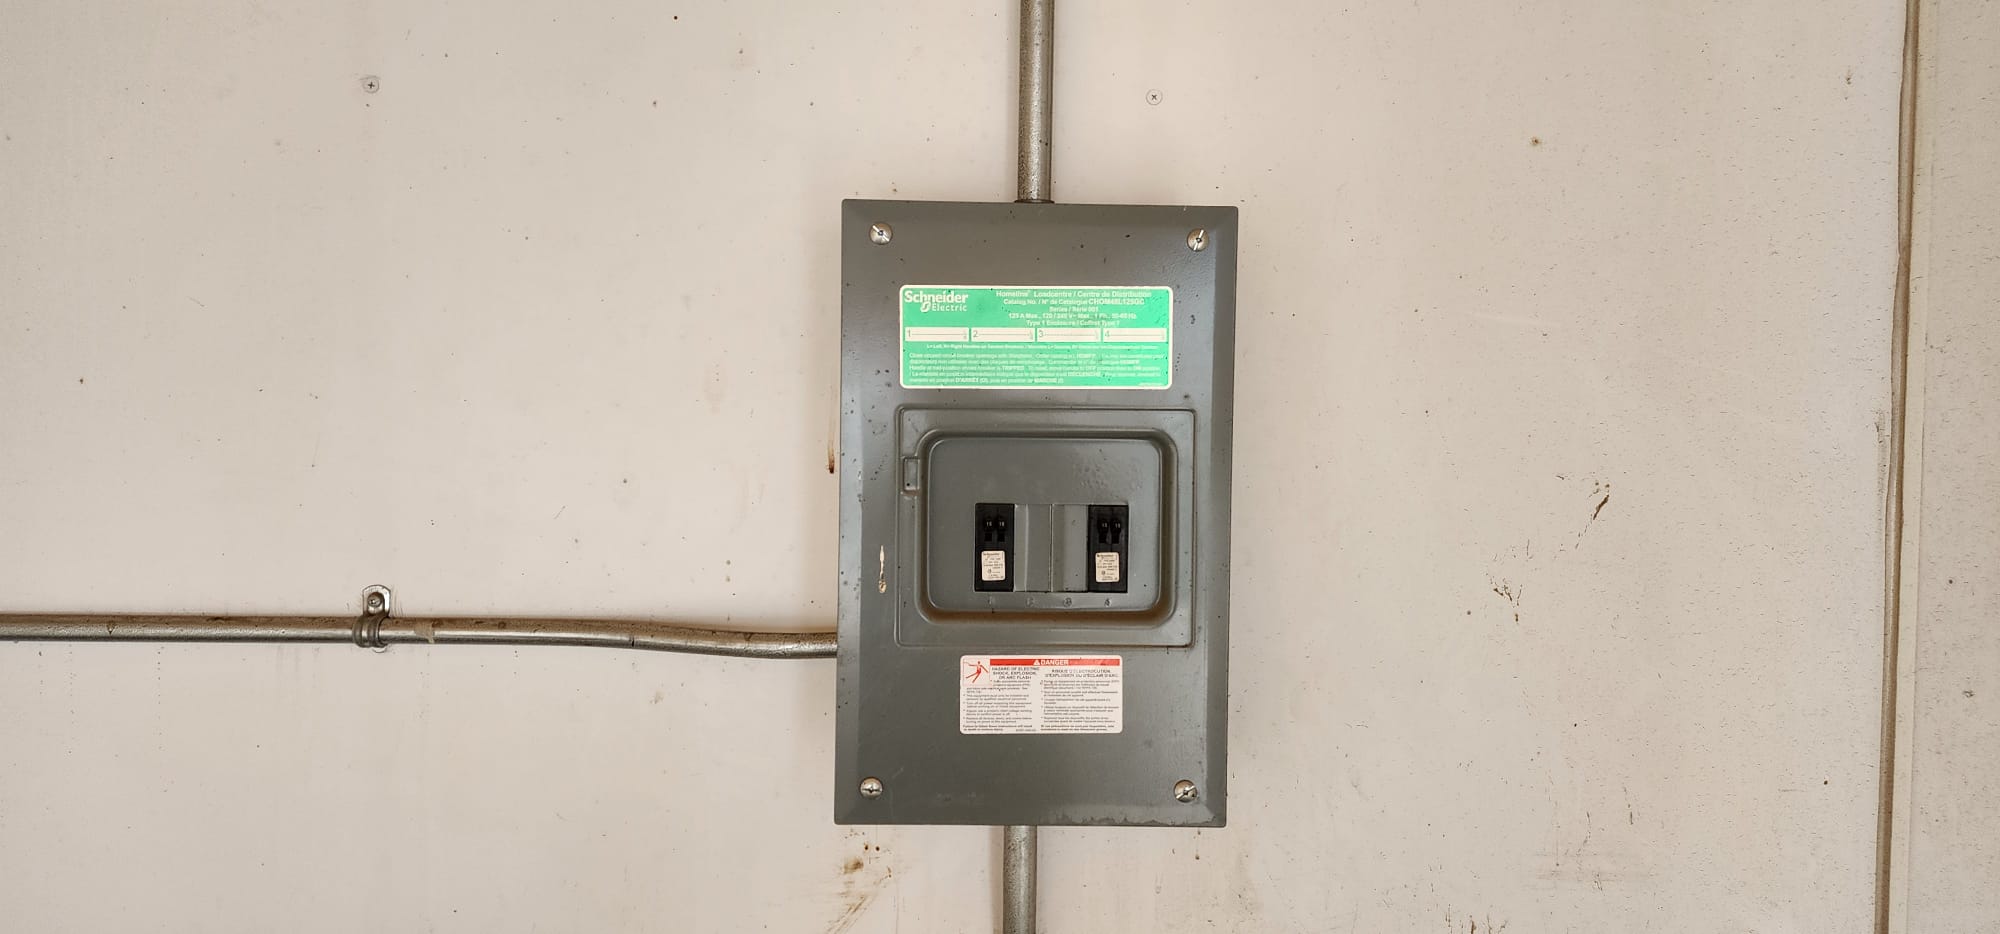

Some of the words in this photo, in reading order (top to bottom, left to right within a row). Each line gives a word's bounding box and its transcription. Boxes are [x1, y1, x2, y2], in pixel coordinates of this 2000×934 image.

[904, 290, 968, 302] Schneider
[906, 330, 912, 338] 1
[973, 330, 979, 338] 2
[1038, 330, 1044, 338] 3
